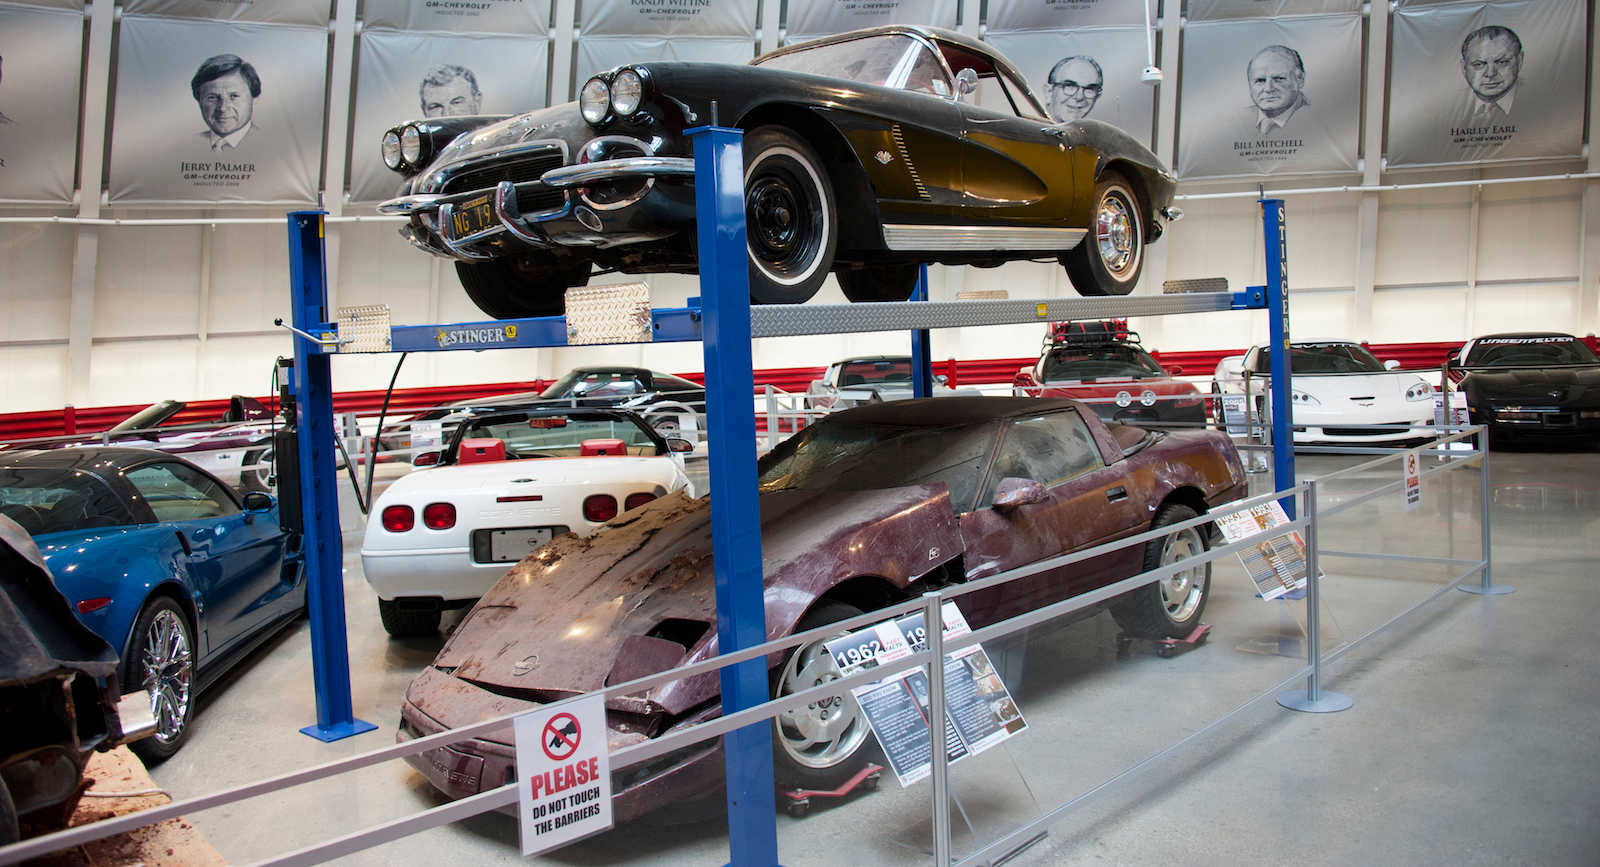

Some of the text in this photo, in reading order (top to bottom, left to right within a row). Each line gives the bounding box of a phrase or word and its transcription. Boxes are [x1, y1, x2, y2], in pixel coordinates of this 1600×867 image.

[1450, 124, 1518, 136] HARLEY EARL
[1233, 139, 1304, 150] BILL MITCHELL
[181, 161, 255, 173] JERRY PALMER
[1278, 207, 1290, 334] STINGER
[450, 328, 504, 344] STINGER
[837, 640, 881, 668] 1962
[530, 756, 600, 801] PLEASE
[533, 786, 600, 820] DO NOT TOUCH
[534, 803, 600, 836] THE BARRIERS
